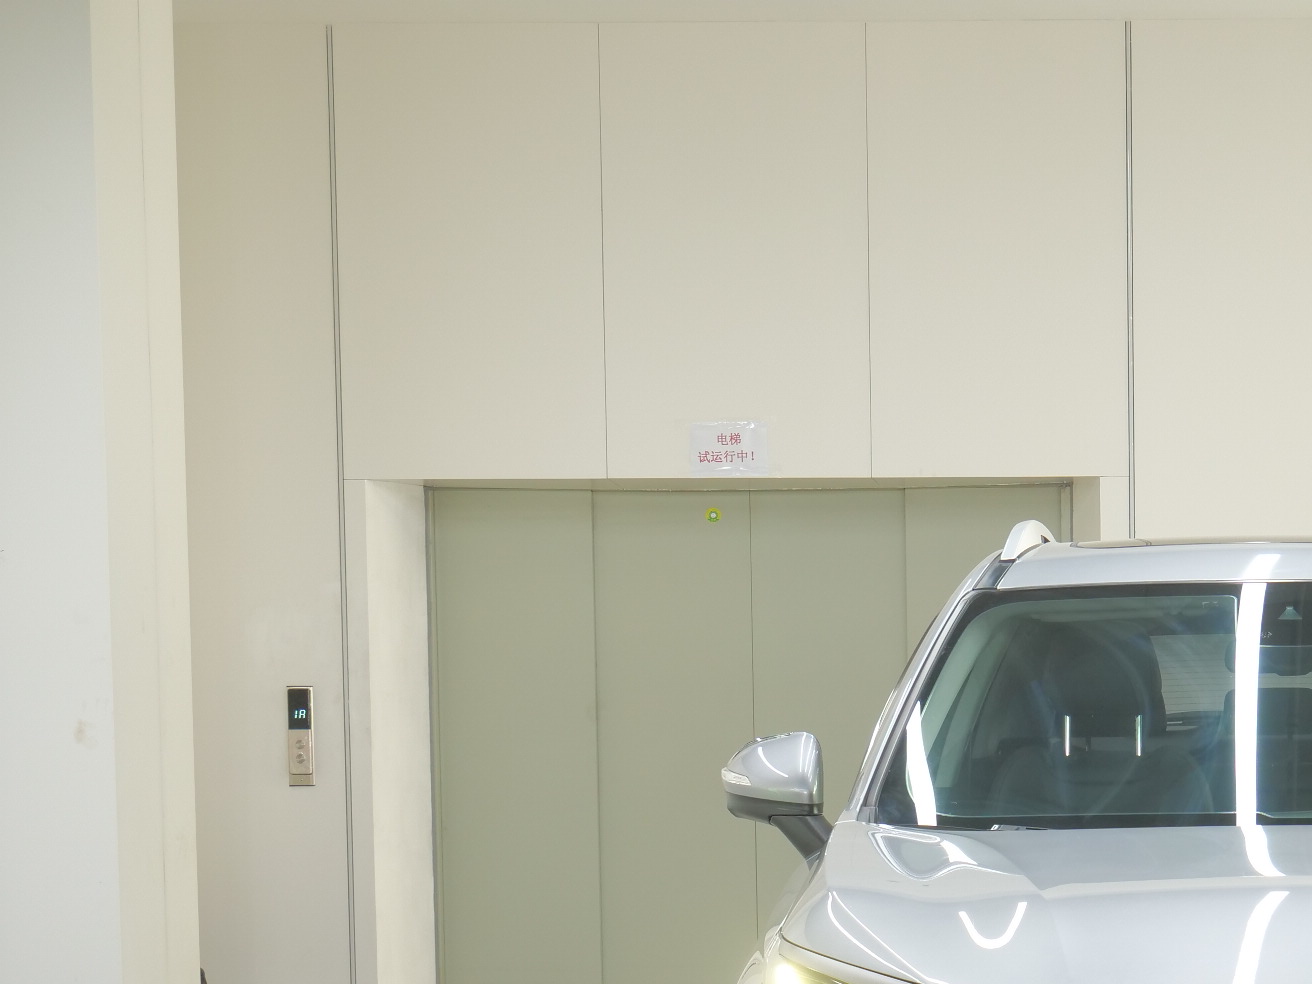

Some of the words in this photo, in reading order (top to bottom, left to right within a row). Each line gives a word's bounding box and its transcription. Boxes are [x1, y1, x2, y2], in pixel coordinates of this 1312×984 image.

[717, 432, 742, 446] 电梯
[697, 449, 755, 464] 试运行中！
